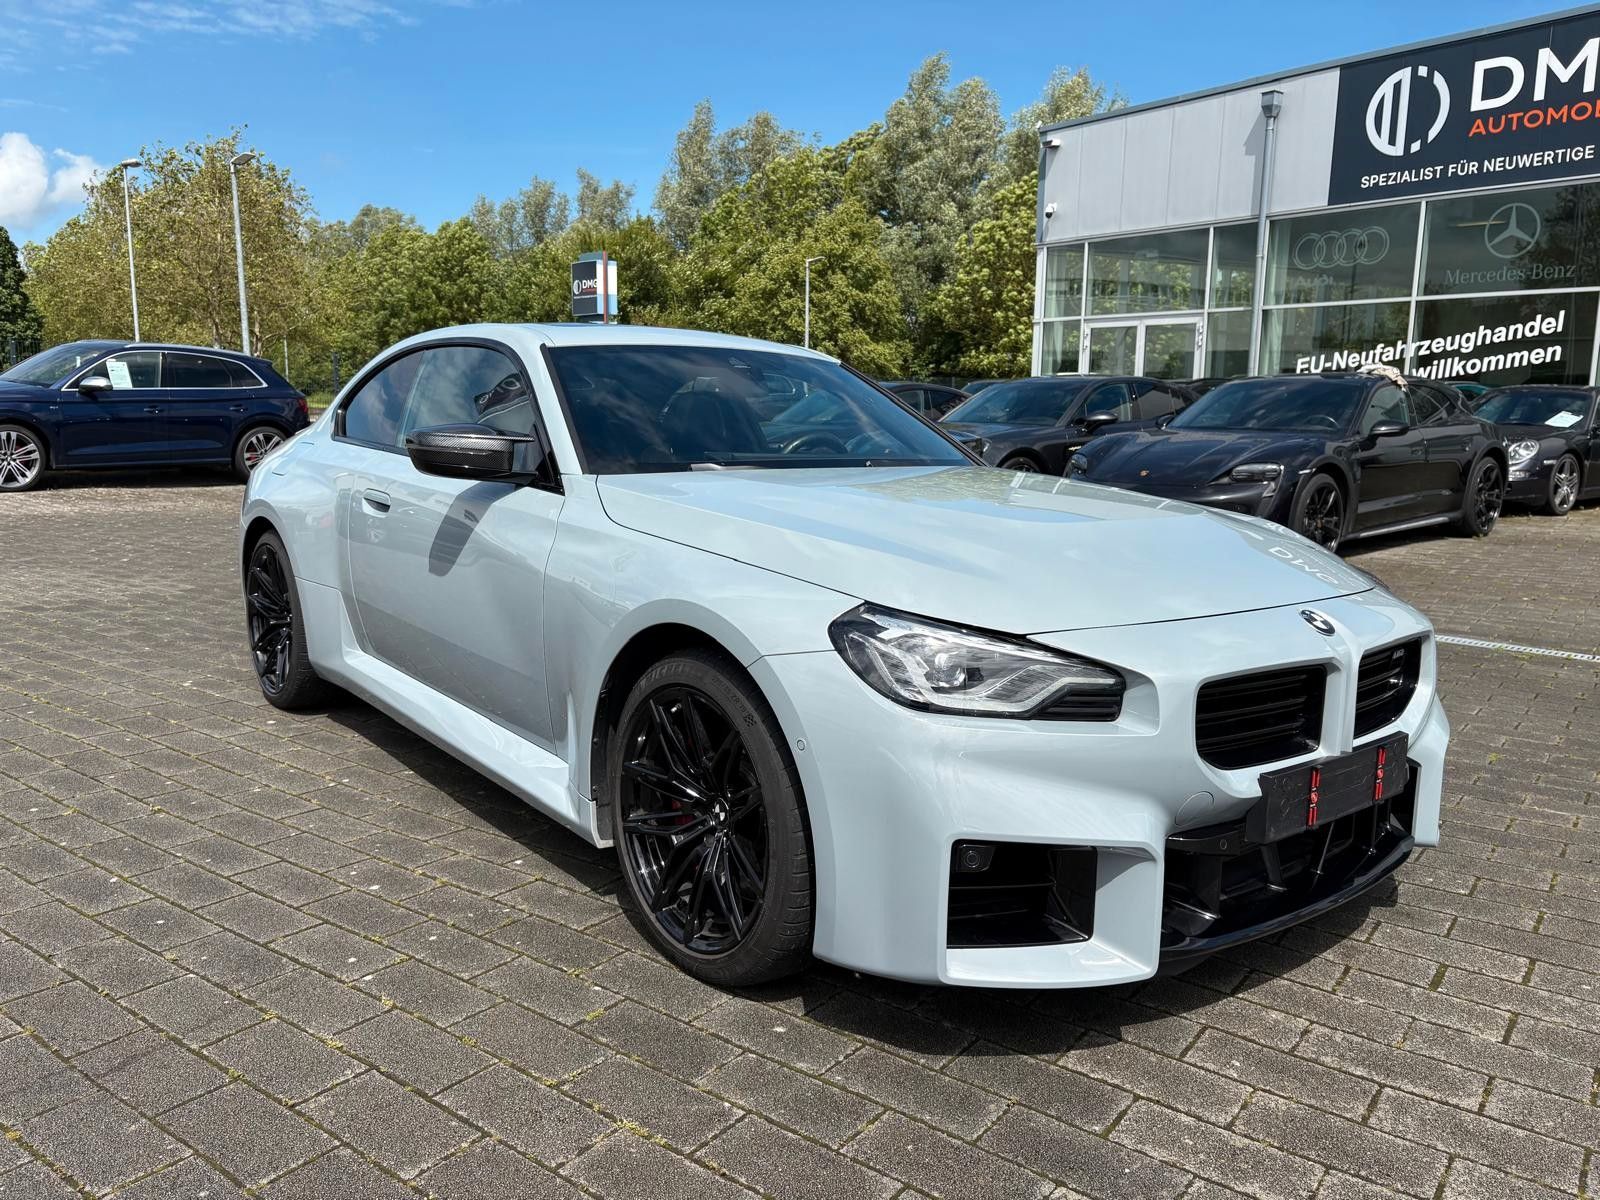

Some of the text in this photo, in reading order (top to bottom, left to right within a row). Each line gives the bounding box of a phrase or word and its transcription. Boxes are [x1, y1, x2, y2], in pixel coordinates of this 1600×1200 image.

[1361, 145, 1595, 188] SPEZIALIST FÜR NEUWERTIGE
[1445, 264, 1576, 284] Mercedes-Benz
[1296, 310, 1565, 374] EU-Neufahrzeughandel
[1412, 345, 1562, 380] willkommen
